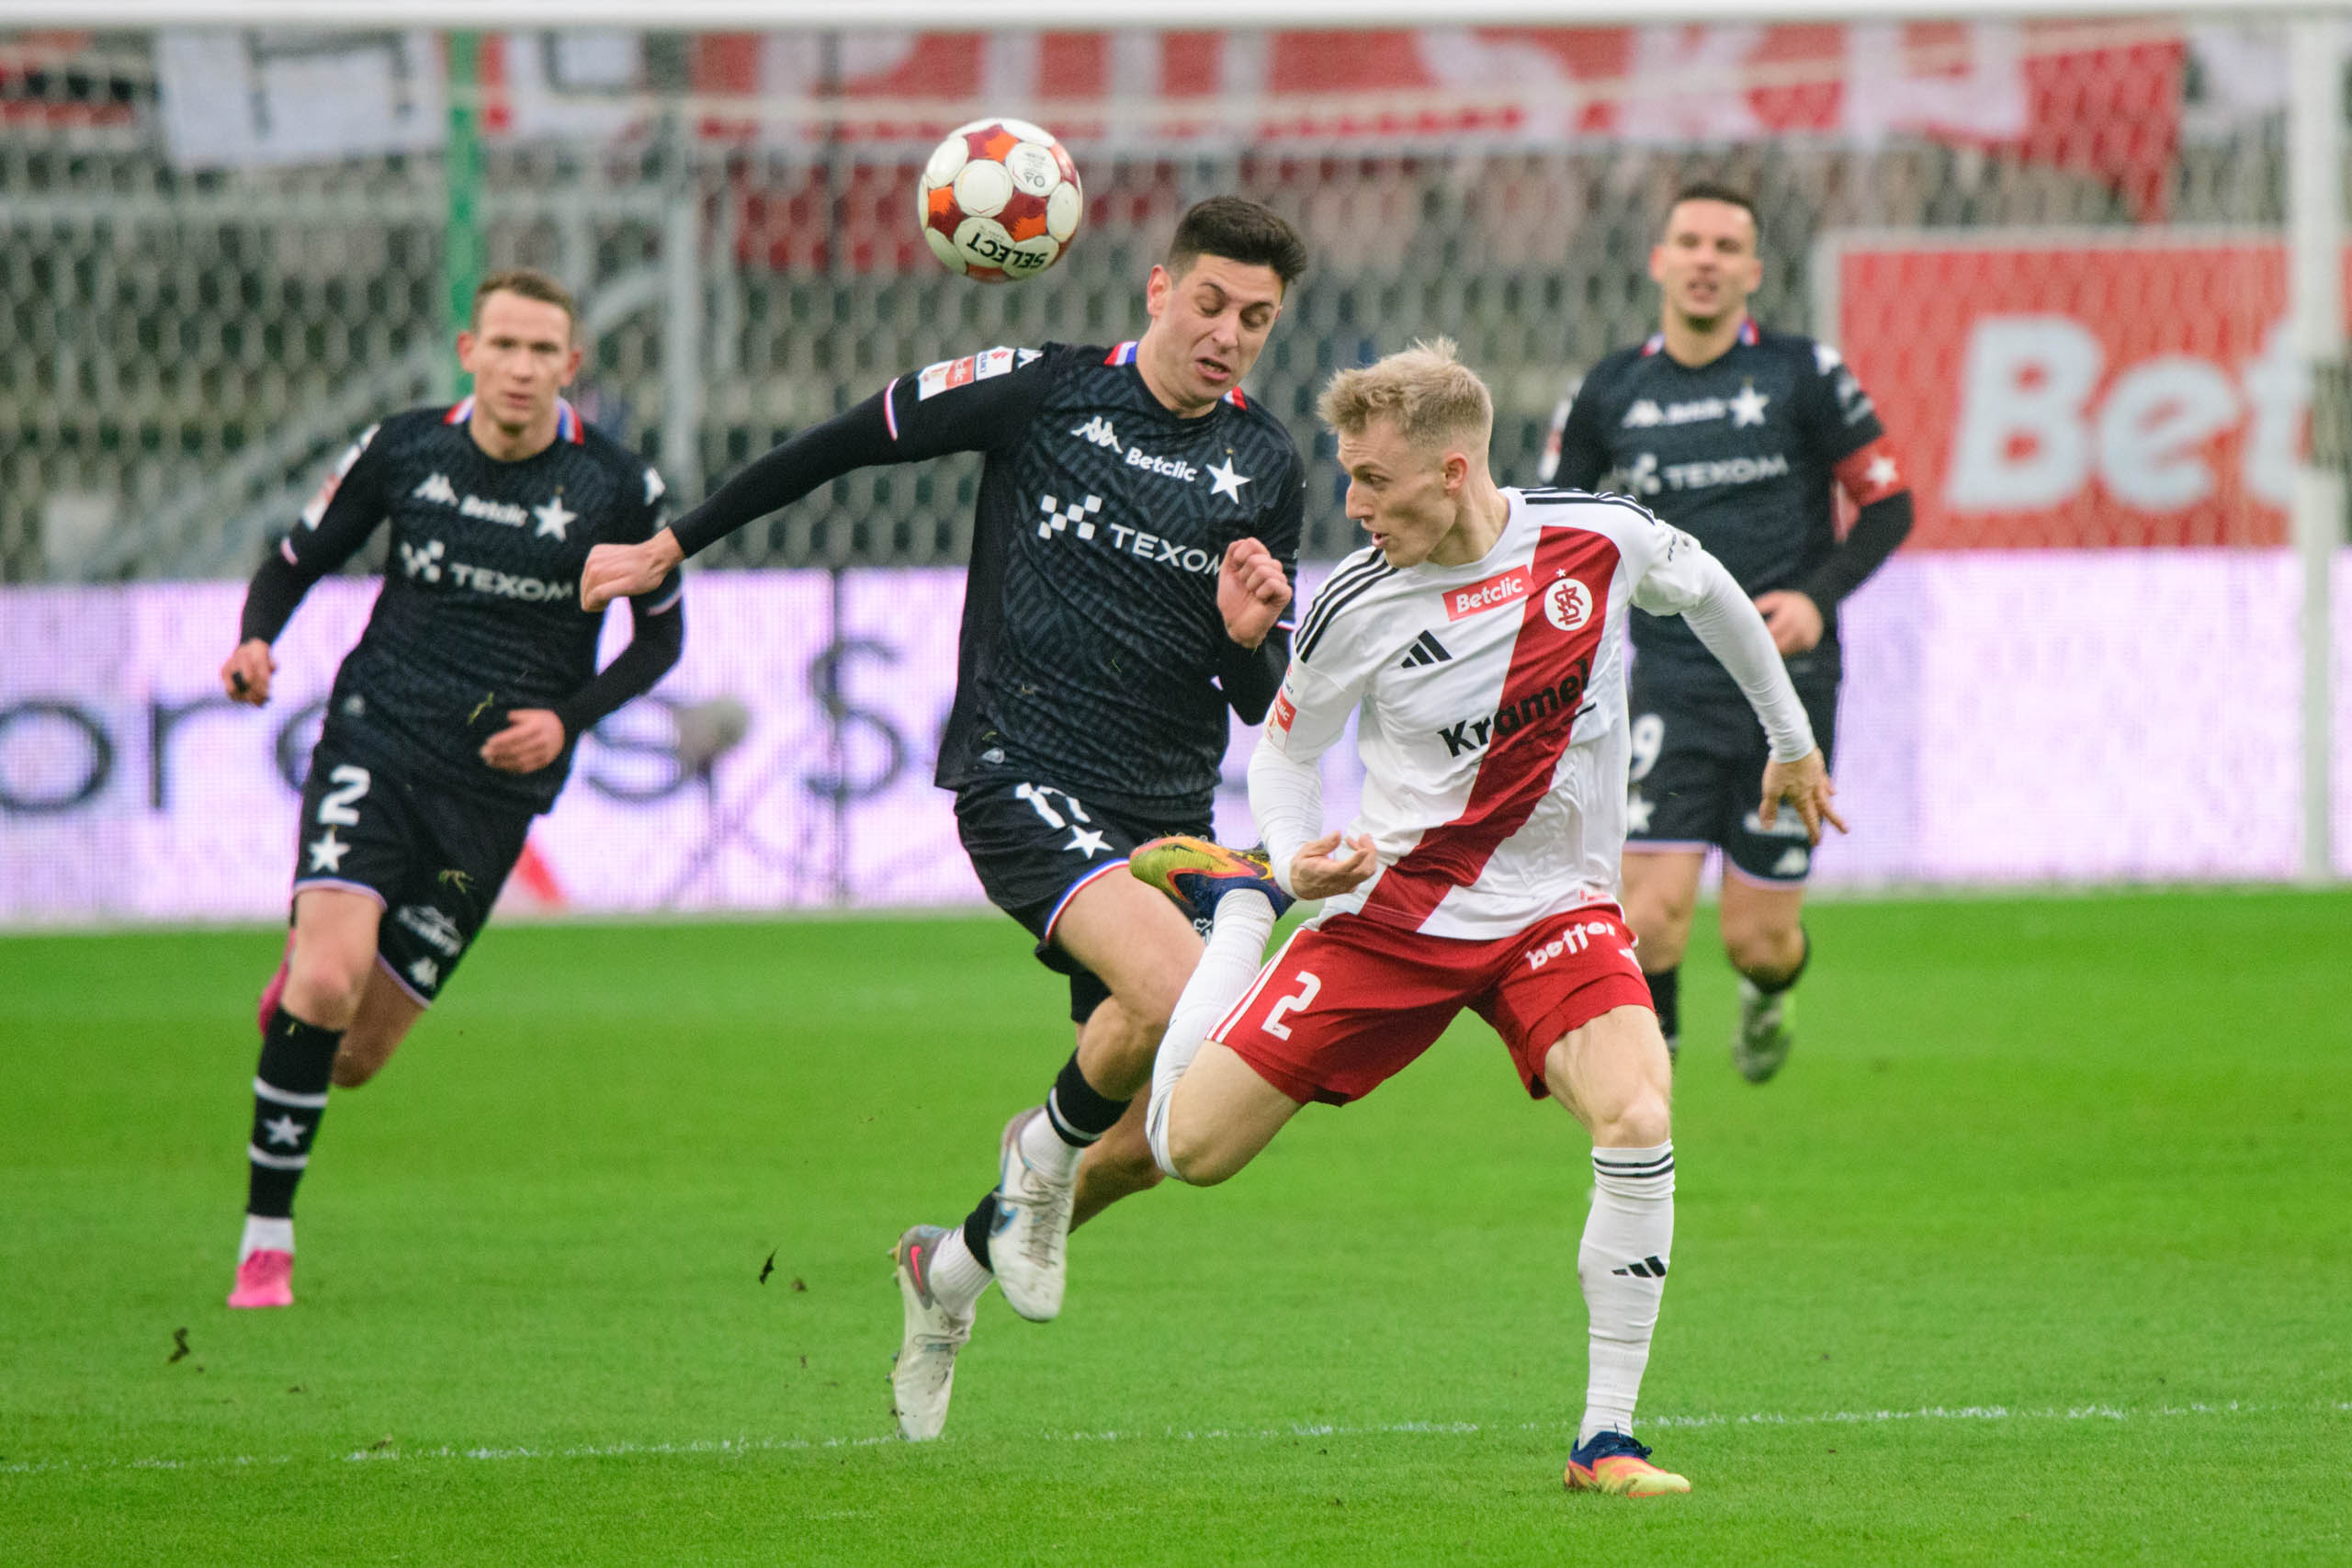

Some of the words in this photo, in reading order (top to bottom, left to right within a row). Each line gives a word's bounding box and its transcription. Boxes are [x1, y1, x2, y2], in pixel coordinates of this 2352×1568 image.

[967, 231, 1049, 269] SELECT
[1125, 446, 1198, 483] Betclic
[449, 562, 574, 603] TEXOM
[1455, 576, 1524, 615] Betclic
[1437, 658, 1589, 758] Kramel
[317, 762, 371, 826] 2
[1261, 970, 1322, 1042] 2
